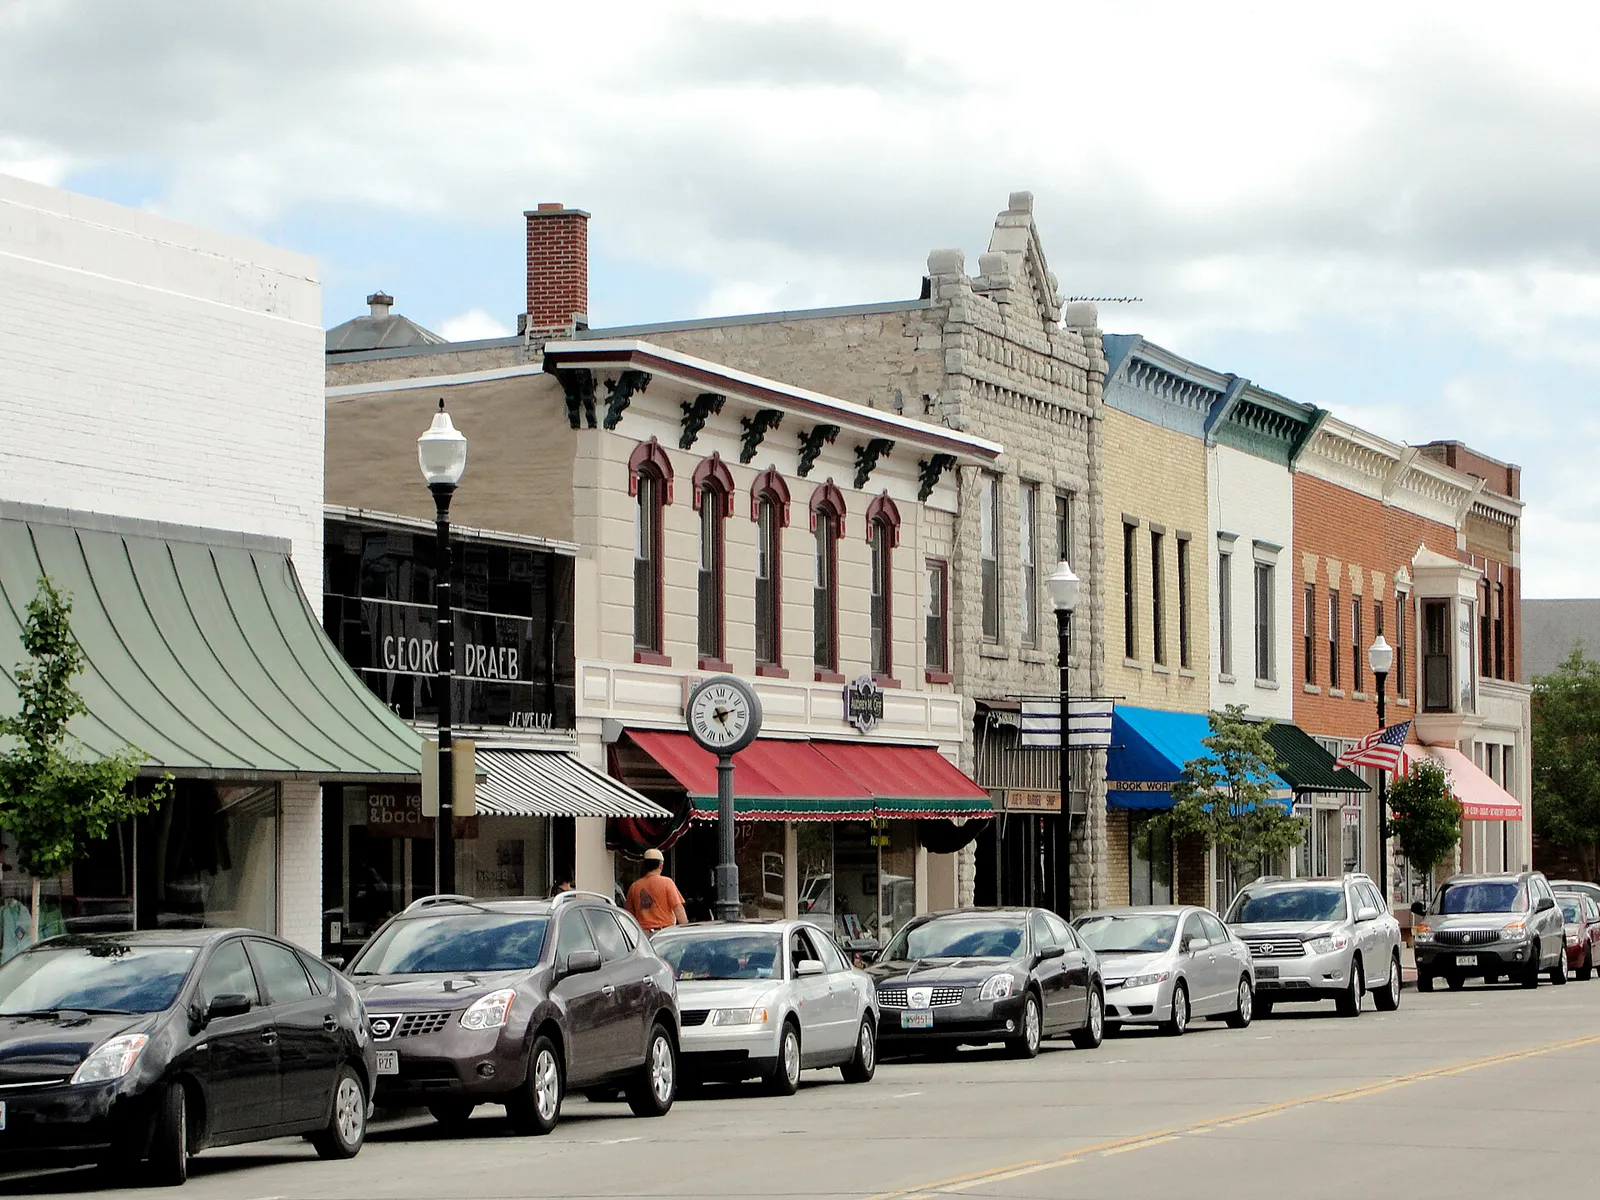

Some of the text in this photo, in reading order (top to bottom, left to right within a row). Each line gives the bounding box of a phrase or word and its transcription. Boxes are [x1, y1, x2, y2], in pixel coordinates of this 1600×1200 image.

[464, 643, 519, 680] DRAEB
[508, 712, 553, 730] JEWELRY
[1116, 781, 1171, 791] BOOK WOR
[378, 1058, 394, 1069] PZF
